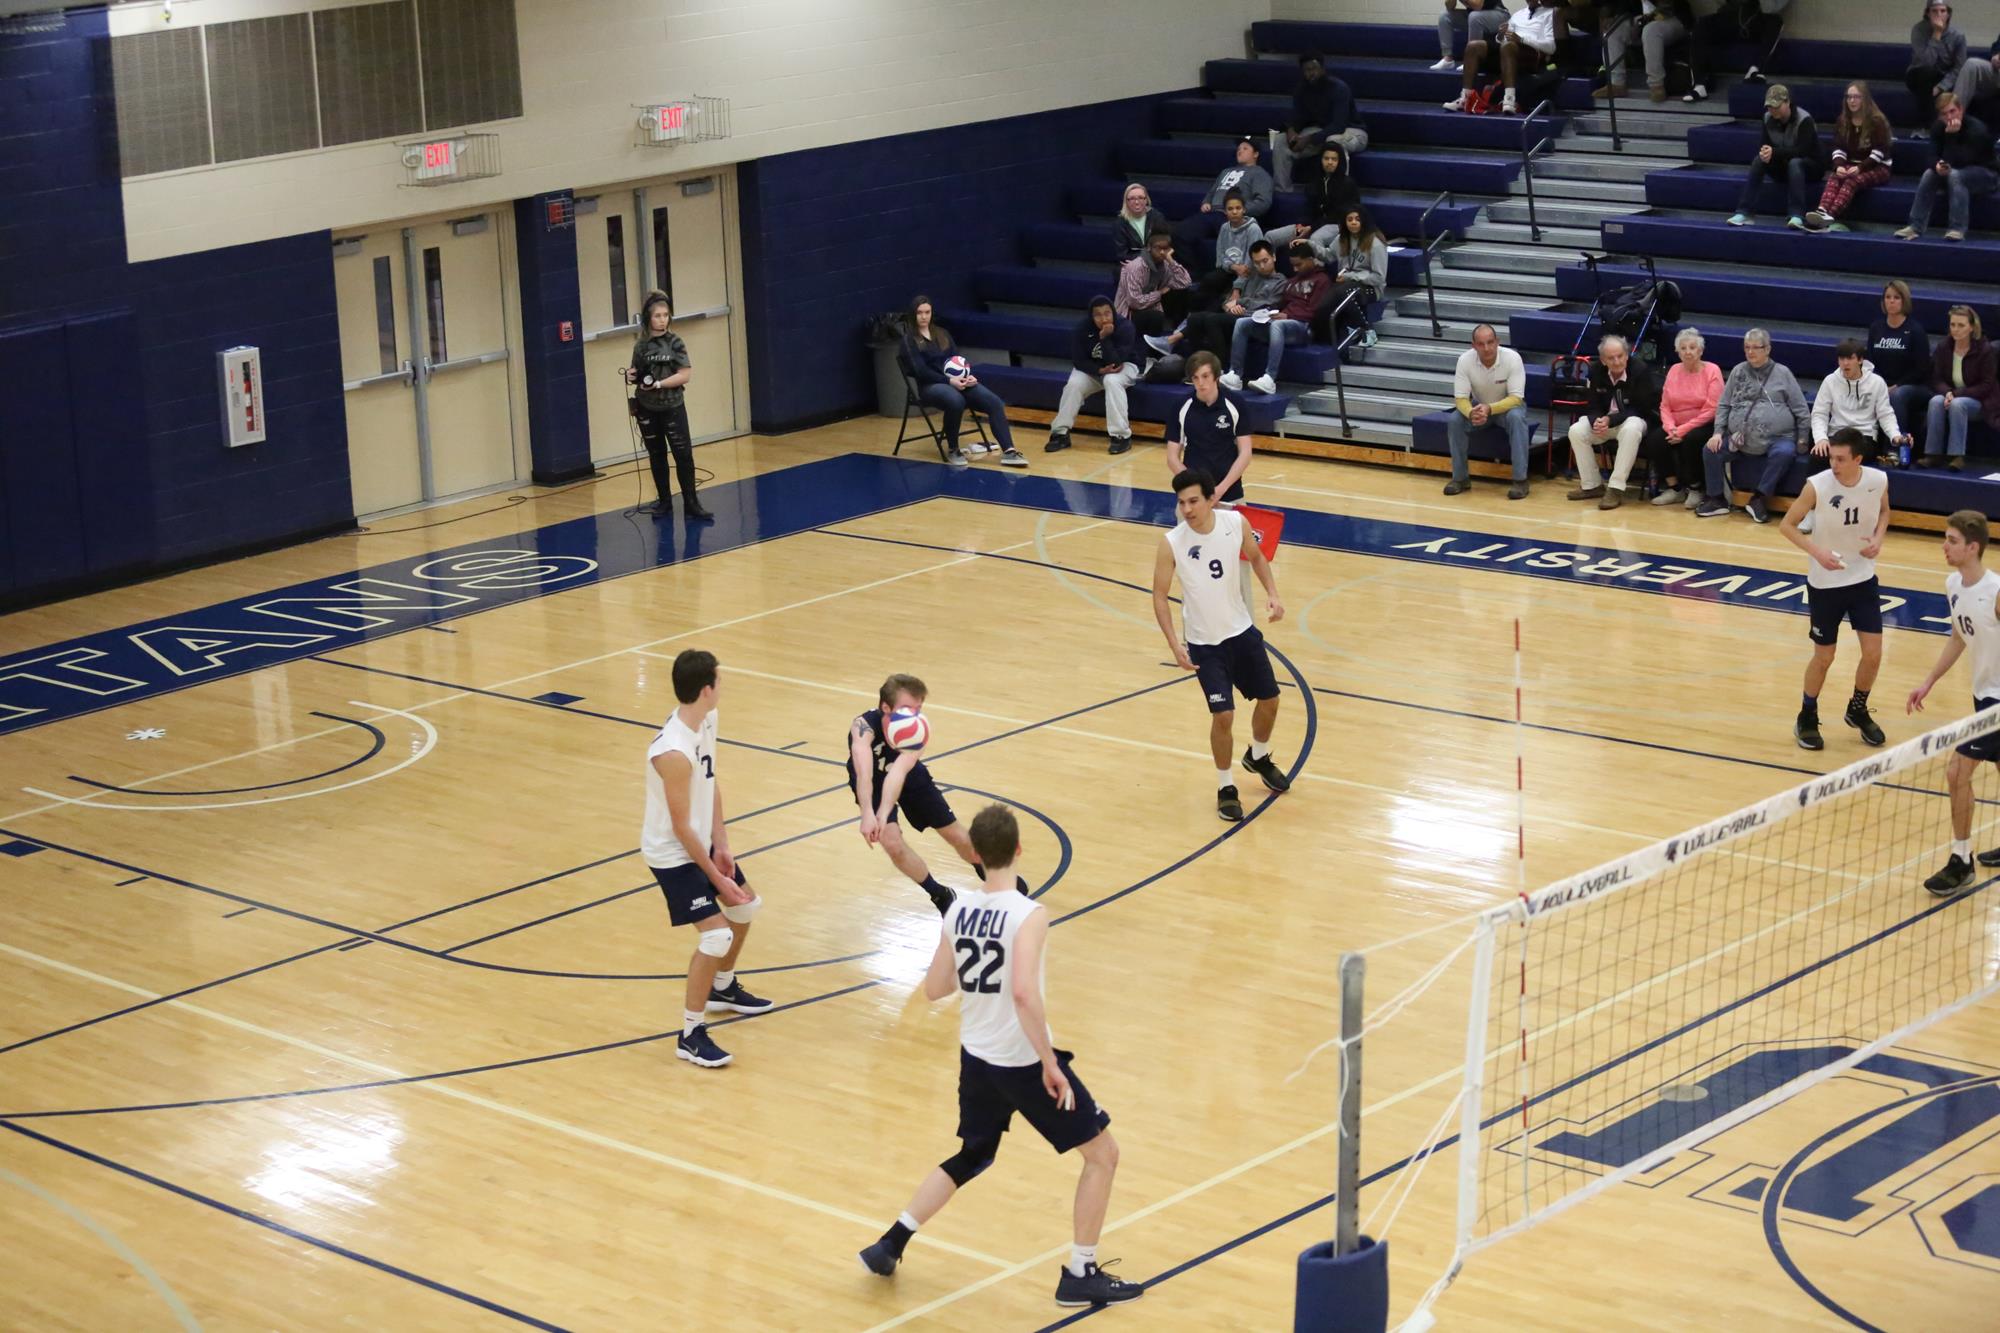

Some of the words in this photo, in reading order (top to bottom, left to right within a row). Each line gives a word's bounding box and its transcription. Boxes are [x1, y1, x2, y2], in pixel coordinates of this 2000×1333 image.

[661, 106, 684, 130] EXIT
[426, 142, 449, 168] EXIT
[1843, 507, 1859, 525] 11
[1208, 558, 1224, 580] 9
[0, 548, 600, 721] TANS
[1957, 613, 1975, 636] 16
[954, 906, 1008, 939] MBU
[955, 938, 1005, 993] 22
